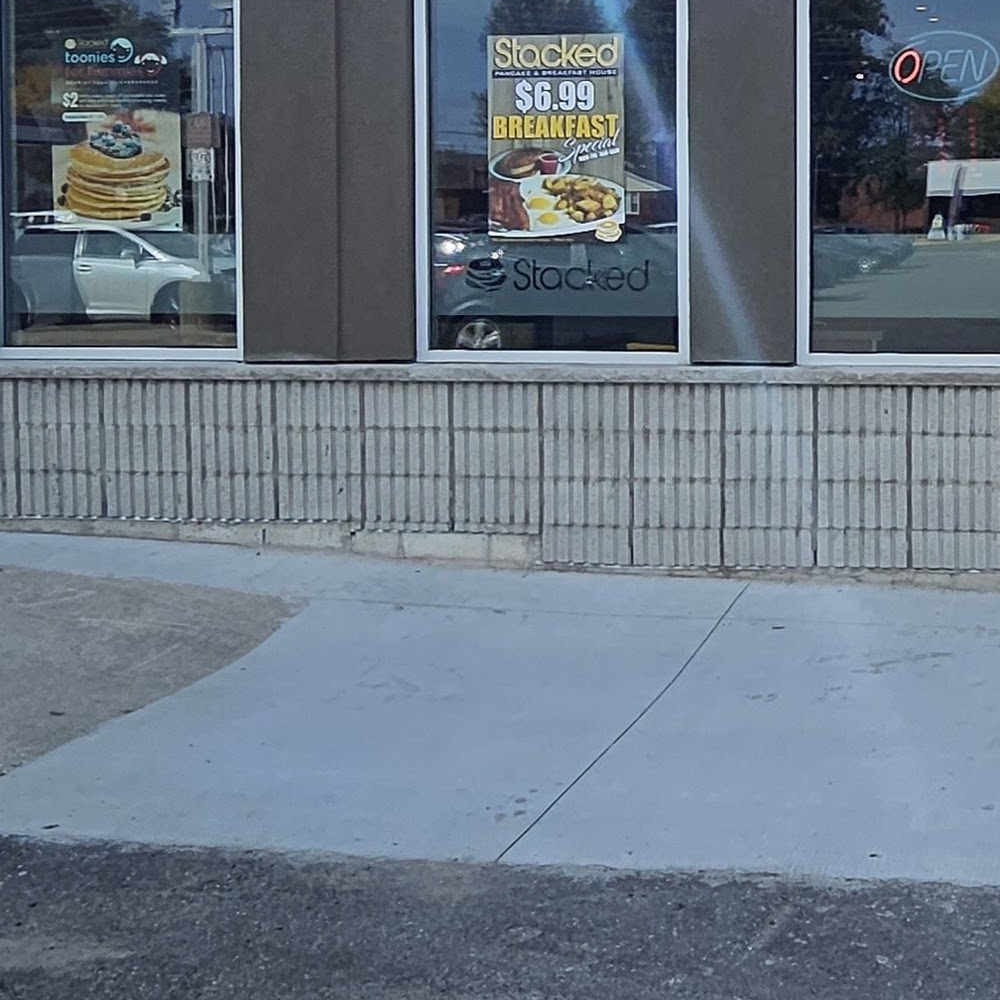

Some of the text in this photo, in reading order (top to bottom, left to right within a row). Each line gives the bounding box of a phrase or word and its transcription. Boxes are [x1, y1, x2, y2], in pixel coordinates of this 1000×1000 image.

[64, 51, 116, 64] toonies
[494, 37, 618, 68] Stacked
[895, 49, 988, 84] OPEN
[62, 92, 79, 108] $2
[515, 79, 594, 113] $6.99
[493, 114, 619, 139] BREAKFAST
[558, 128, 620, 165] Special
[513, 257, 650, 292] Stacked
